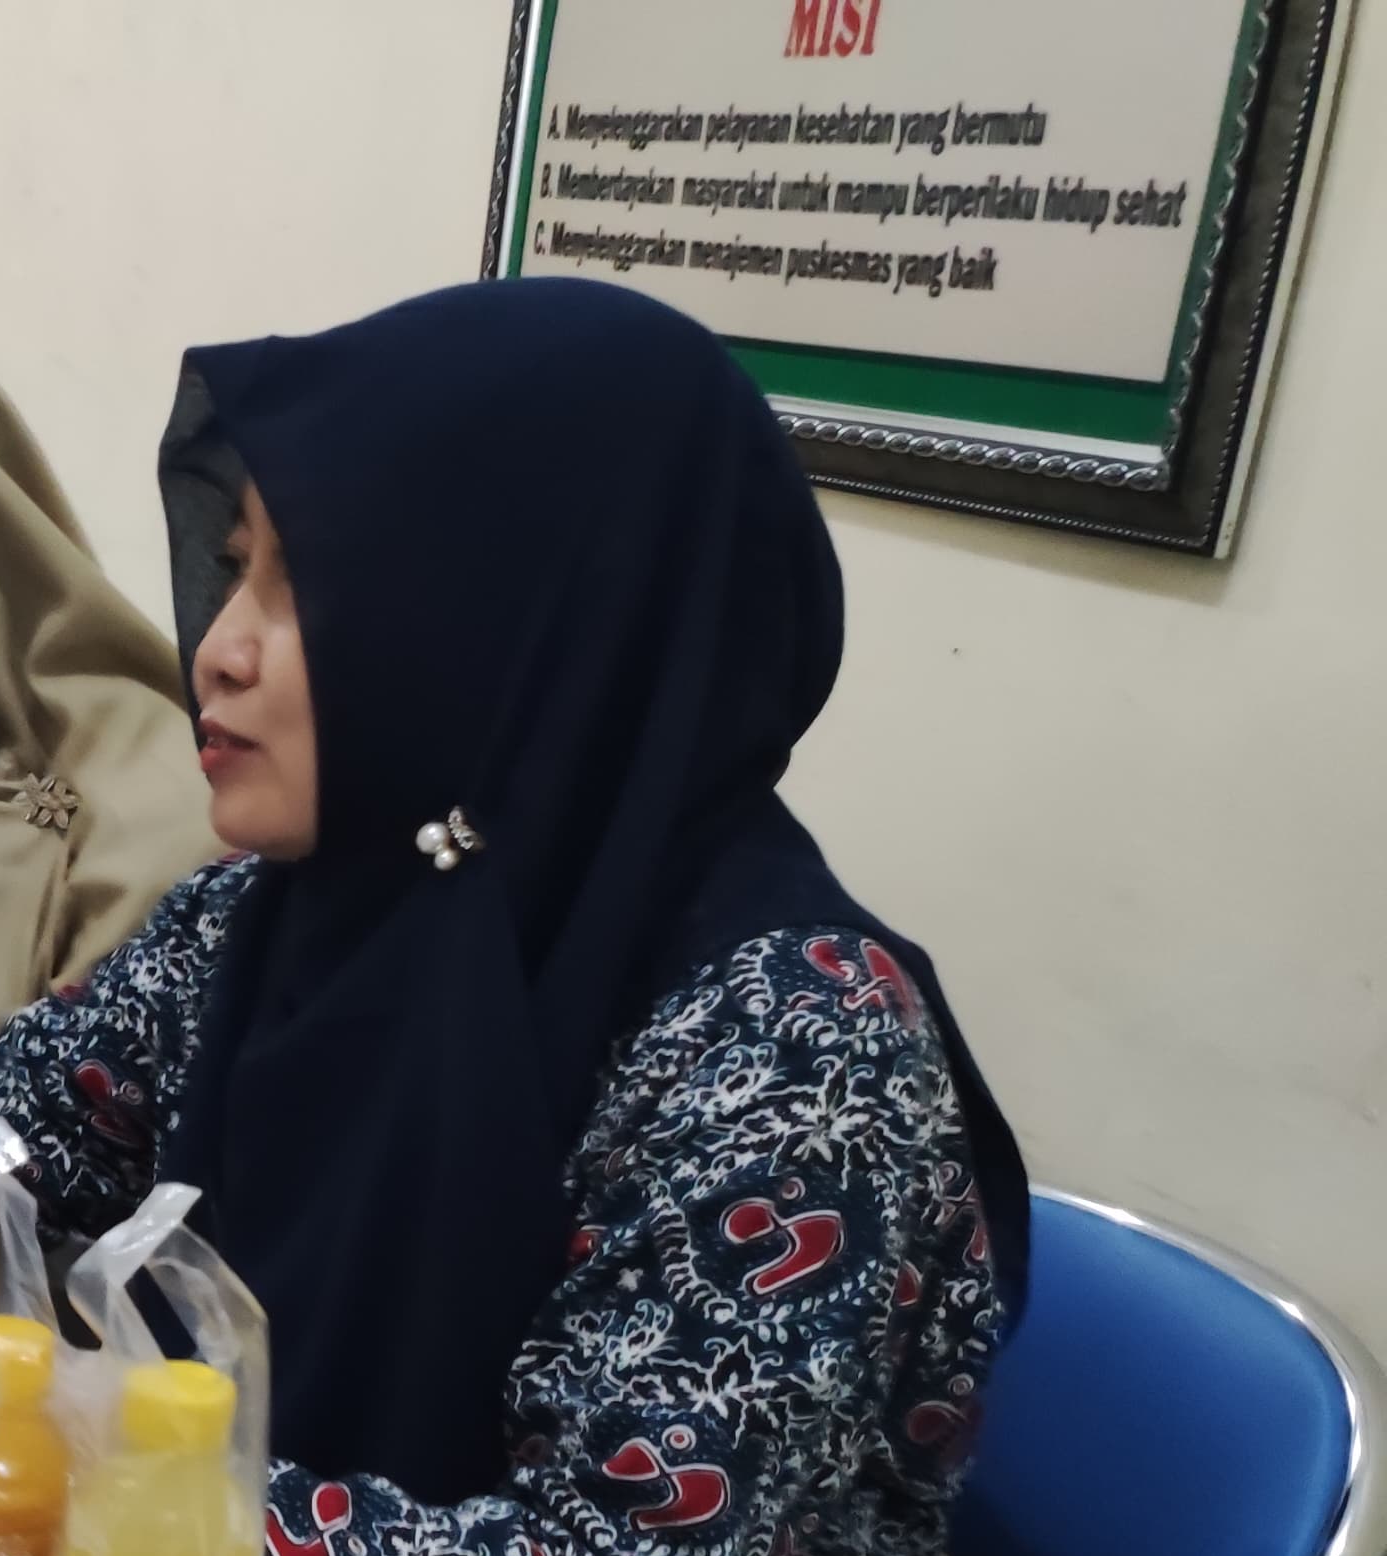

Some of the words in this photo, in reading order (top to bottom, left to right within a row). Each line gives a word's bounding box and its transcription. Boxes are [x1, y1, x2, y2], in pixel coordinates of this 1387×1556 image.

[783, 0, 883, 57] MISI
[547, 104, 561, 140] A.
[564, 104, 704, 151] Menyelenggarakan
[704, 104, 792, 152] pelayanan
[793, 103, 895, 145] kesehatan
[894, 107, 951, 155] yang
[951, 101, 1047, 146] bermutu
[540, 162, 553, 199] B.
[681, 169, 777, 216] masyarakat
[777, 172, 831, 212] untuk
[833, 181, 910, 225] mampu
[911, 172, 1040, 227] berperilaku
[1042, 176, 1110, 233] hidup
[1113, 177, 1187, 228] sehat
[534, 219, 546, 255] C.
[549, 221, 686, 272] Menyelenggarakan
[784, 239, 892, 286] puskesmas
[892, 251, 948, 298] yang
[948, 245, 997, 290] baik
